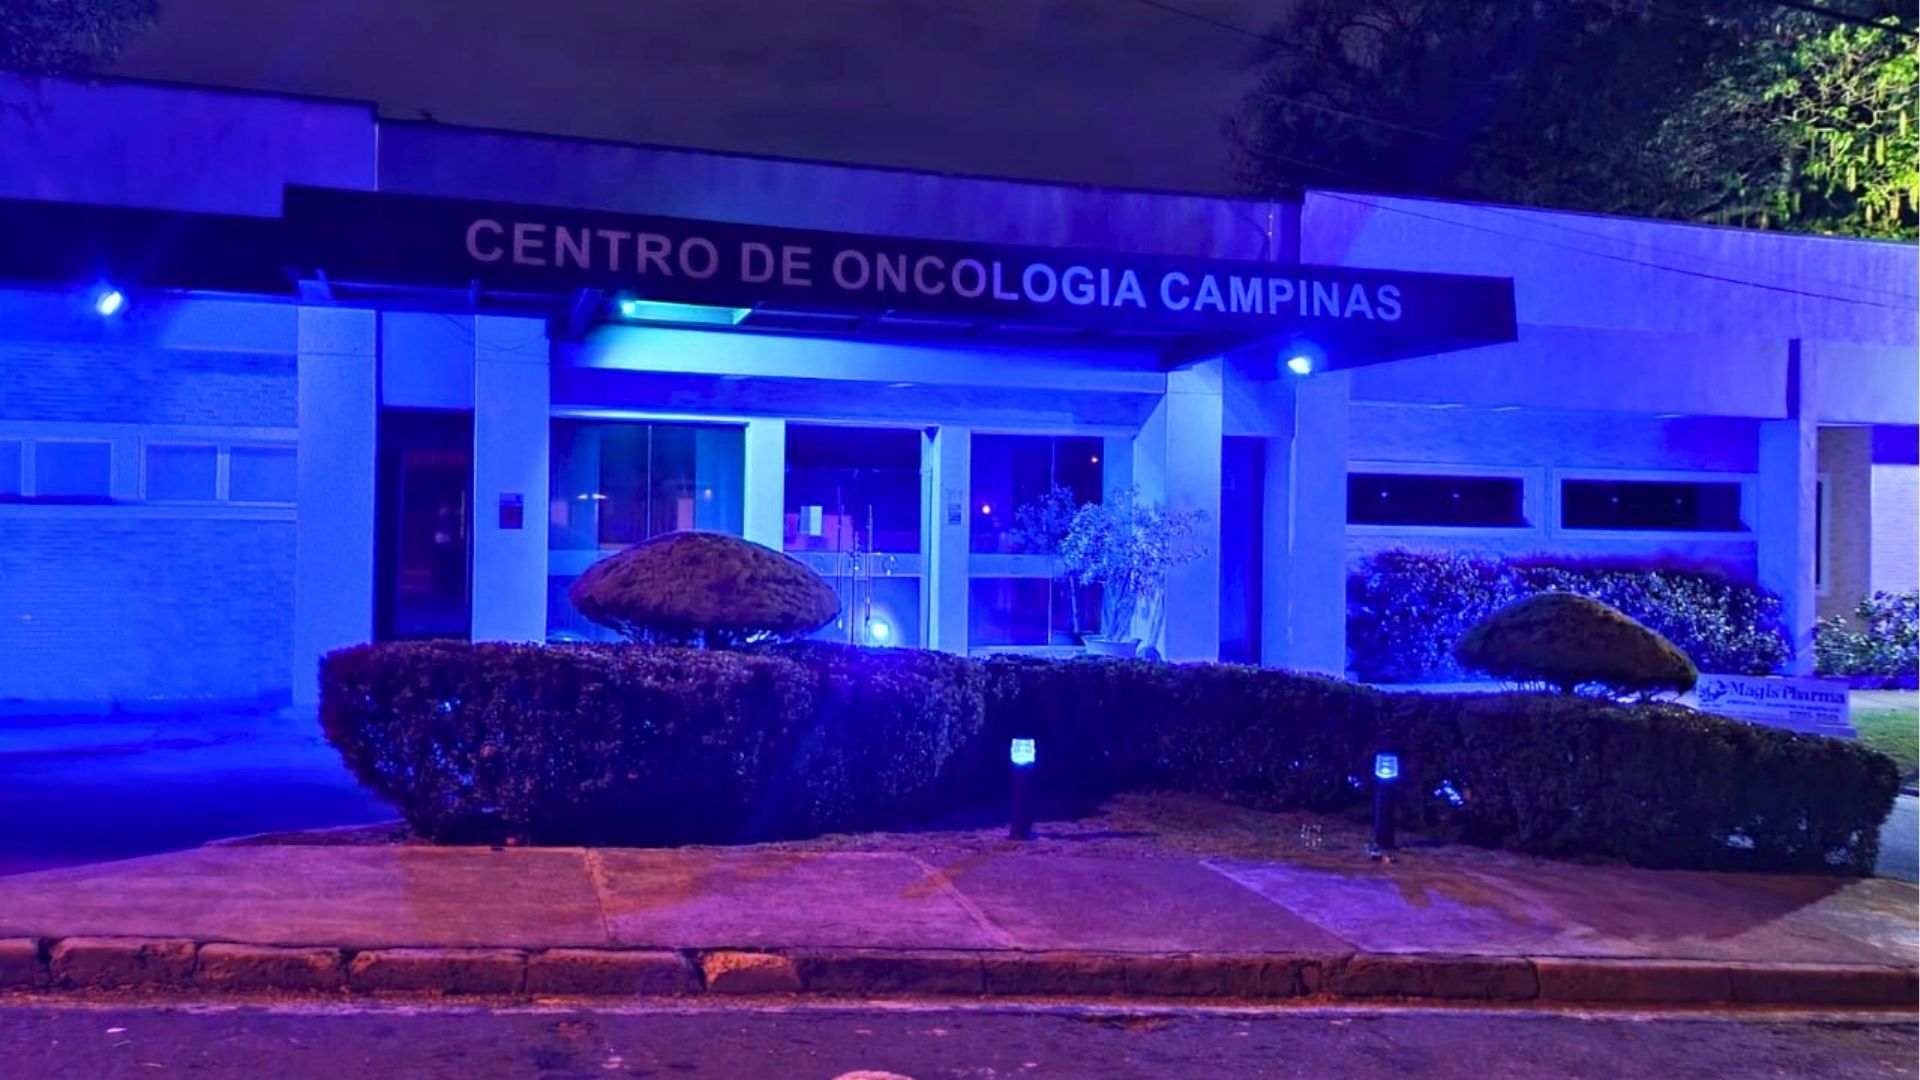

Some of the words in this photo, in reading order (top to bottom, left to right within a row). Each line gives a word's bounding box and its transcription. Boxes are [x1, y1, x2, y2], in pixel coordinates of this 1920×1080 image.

[465, 218, 719, 280] CENTRO
[740, 241, 813, 287] DE
[831, 249, 1147, 308] ONCOLOGIA
[1159, 271, 1402, 321] CAMPINAS
[1729, 681, 1780, 700] Magis
[1781, 685, 1846, 704] Pharma
